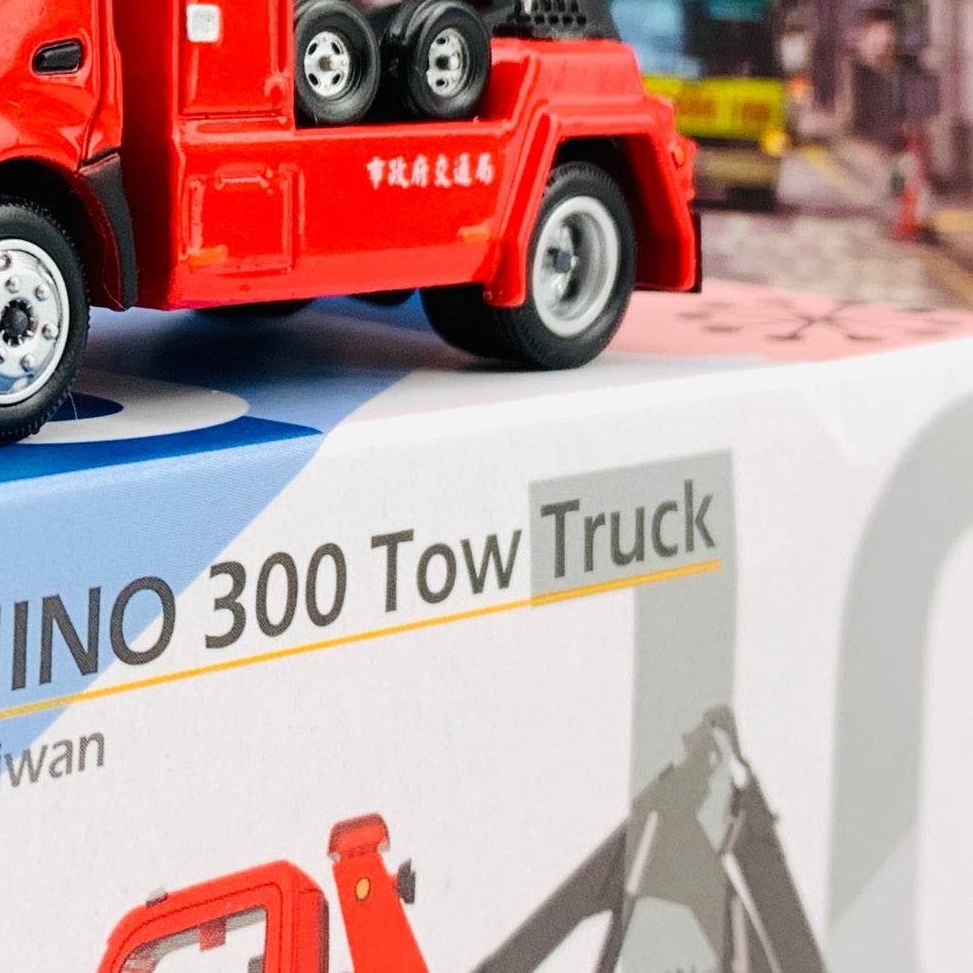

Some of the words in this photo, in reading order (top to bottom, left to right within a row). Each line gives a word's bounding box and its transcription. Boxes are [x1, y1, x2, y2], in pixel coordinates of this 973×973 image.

[366, 153, 494, 189] 市政府交通局
[204, 541, 347, 649] 300
[370, 528, 522, 613] Tow
[540, 478, 717, 578] Truck
